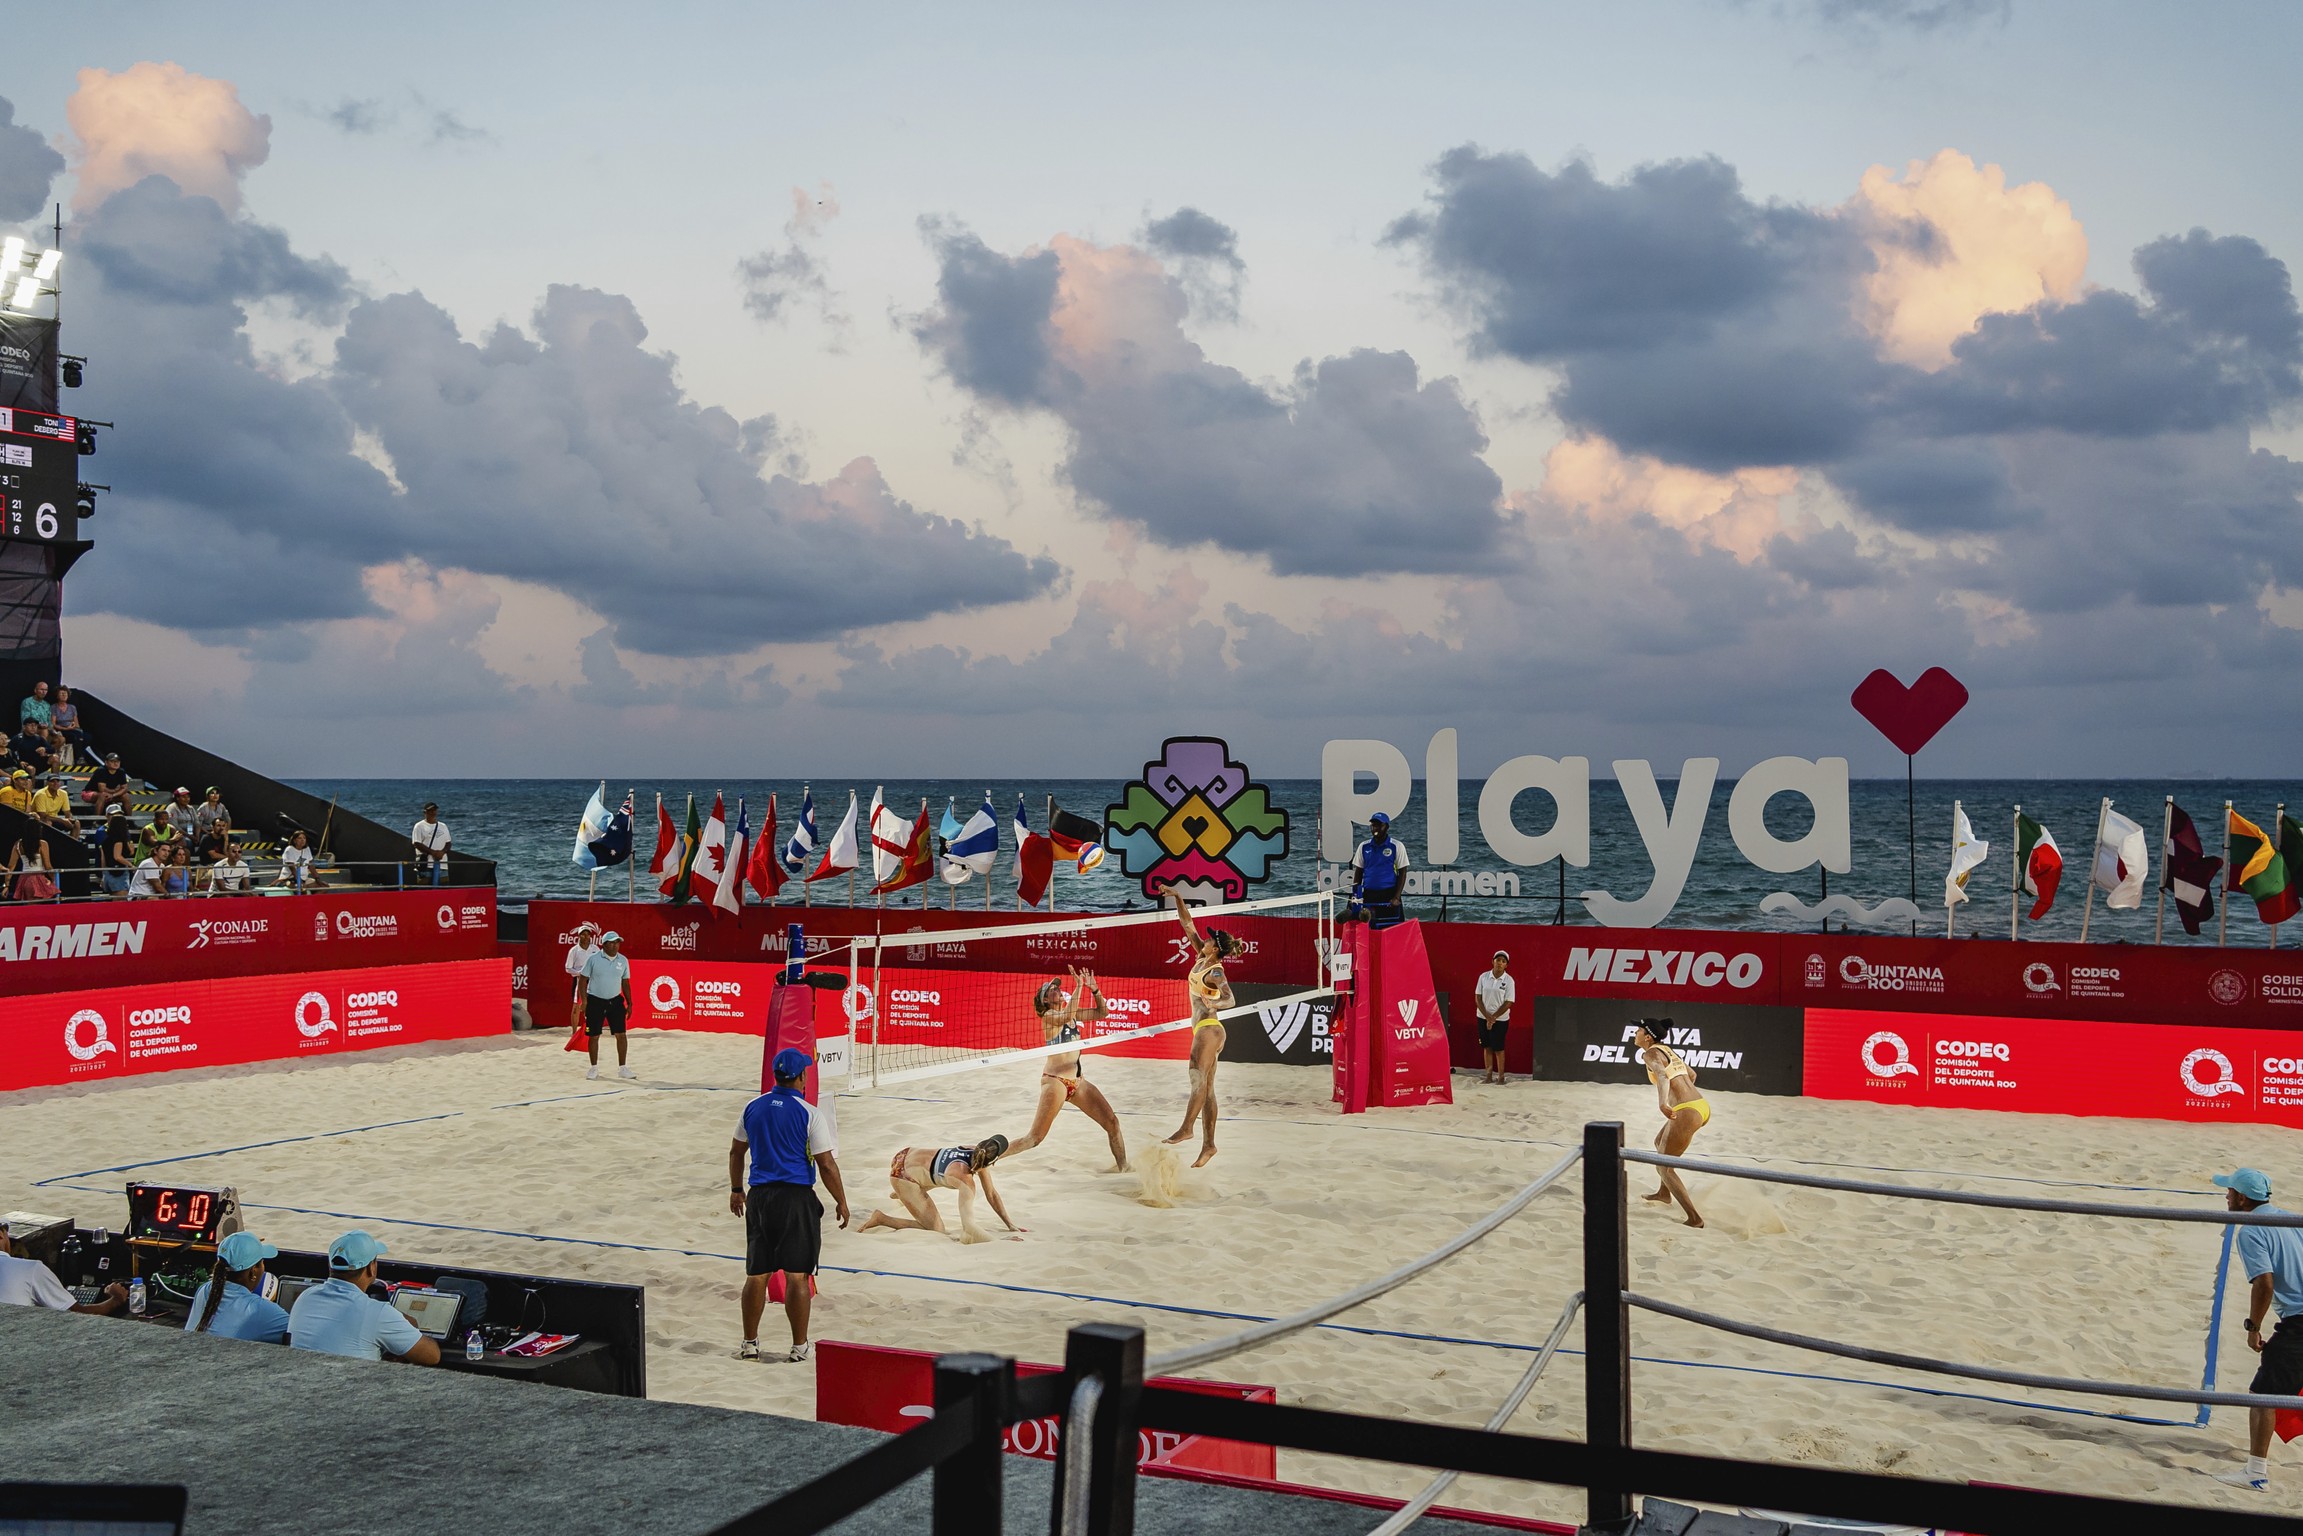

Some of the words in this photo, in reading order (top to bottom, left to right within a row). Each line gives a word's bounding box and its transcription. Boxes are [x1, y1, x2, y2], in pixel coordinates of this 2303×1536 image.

[0, 346, 30, 361] ODEQ
[44, 418, 59, 427] TONI
[12, 499, 22, 510] 21
[12, 512, 22, 522] 12
[36, 502, 58, 539] 6
[13, 525, 20, 535] 6
[1321, 727, 1851, 928] Playa
[1320, 863, 1355, 893] de
[1403, 868, 1520, 898] armen
[461, 906, 486, 915] CODEQ
[213, 919, 268, 934] CONADE
[336, 911, 397, 934] QUINTANA
[353, 927, 375, 938] ROO
[558, 933, 603, 945] Eleclit
[1026, 939, 1097, 951] MEXICANO
[937, 943, 966, 953] MAYA
[1563, 947, 1763, 989] MEXICO
[1839, 955, 1944, 983] QUINTANA
[2071, 967, 2120, 980] CODEQ
[695, 981, 741, 997] CODEQ
[1867, 977, 1904, 990] ROO
[890, 989, 940, 1006] CODEQ
[2262, 986, 2303, 997] SOLID
[347, 990, 398, 1008] CODEQ
[1103, 998, 1150, 1015] ODEQ
[129, 1005, 191, 1026] CODEQ
[348, 1008, 378, 1018] COMISIÓN
[361, 1017, 388, 1026] DEPORTE
[899, 1019, 929, 1027] QUINTANA
[1109, 1021, 1139, 1029] DEPORTE
[130, 1026, 167, 1038] COMISIÓN
[358, 1026, 388, 1036] QUINTANA
[1395, 1027, 1425, 1040] VBTV
[130, 1039, 144, 1048] DEL
[146, 1035, 180, 1046] DEPORTE
[130, 1049, 140, 1058] DE
[142, 1045, 180, 1057] QUINTANA
[181, 1043, 197, 1051] ROO
[821, 1050, 843, 1063] VBTV
[1582, 1044, 1630, 1064] DEL
[1935, 1040, 2010, 1062] CODEQ
[1935, 1058, 1978, 1067] COMISIÓN
[1935, 1067, 1952, 1075] DEL
[1953, 1068, 1994, 1078] DEPORTE
[1949, 1077, 1995, 1088] QUINTANA
[1997, 1081, 2016, 1089] ROO
[2263, 1086, 2281, 1095] DEL
[2262, 1096, 2276, 1104] DE
